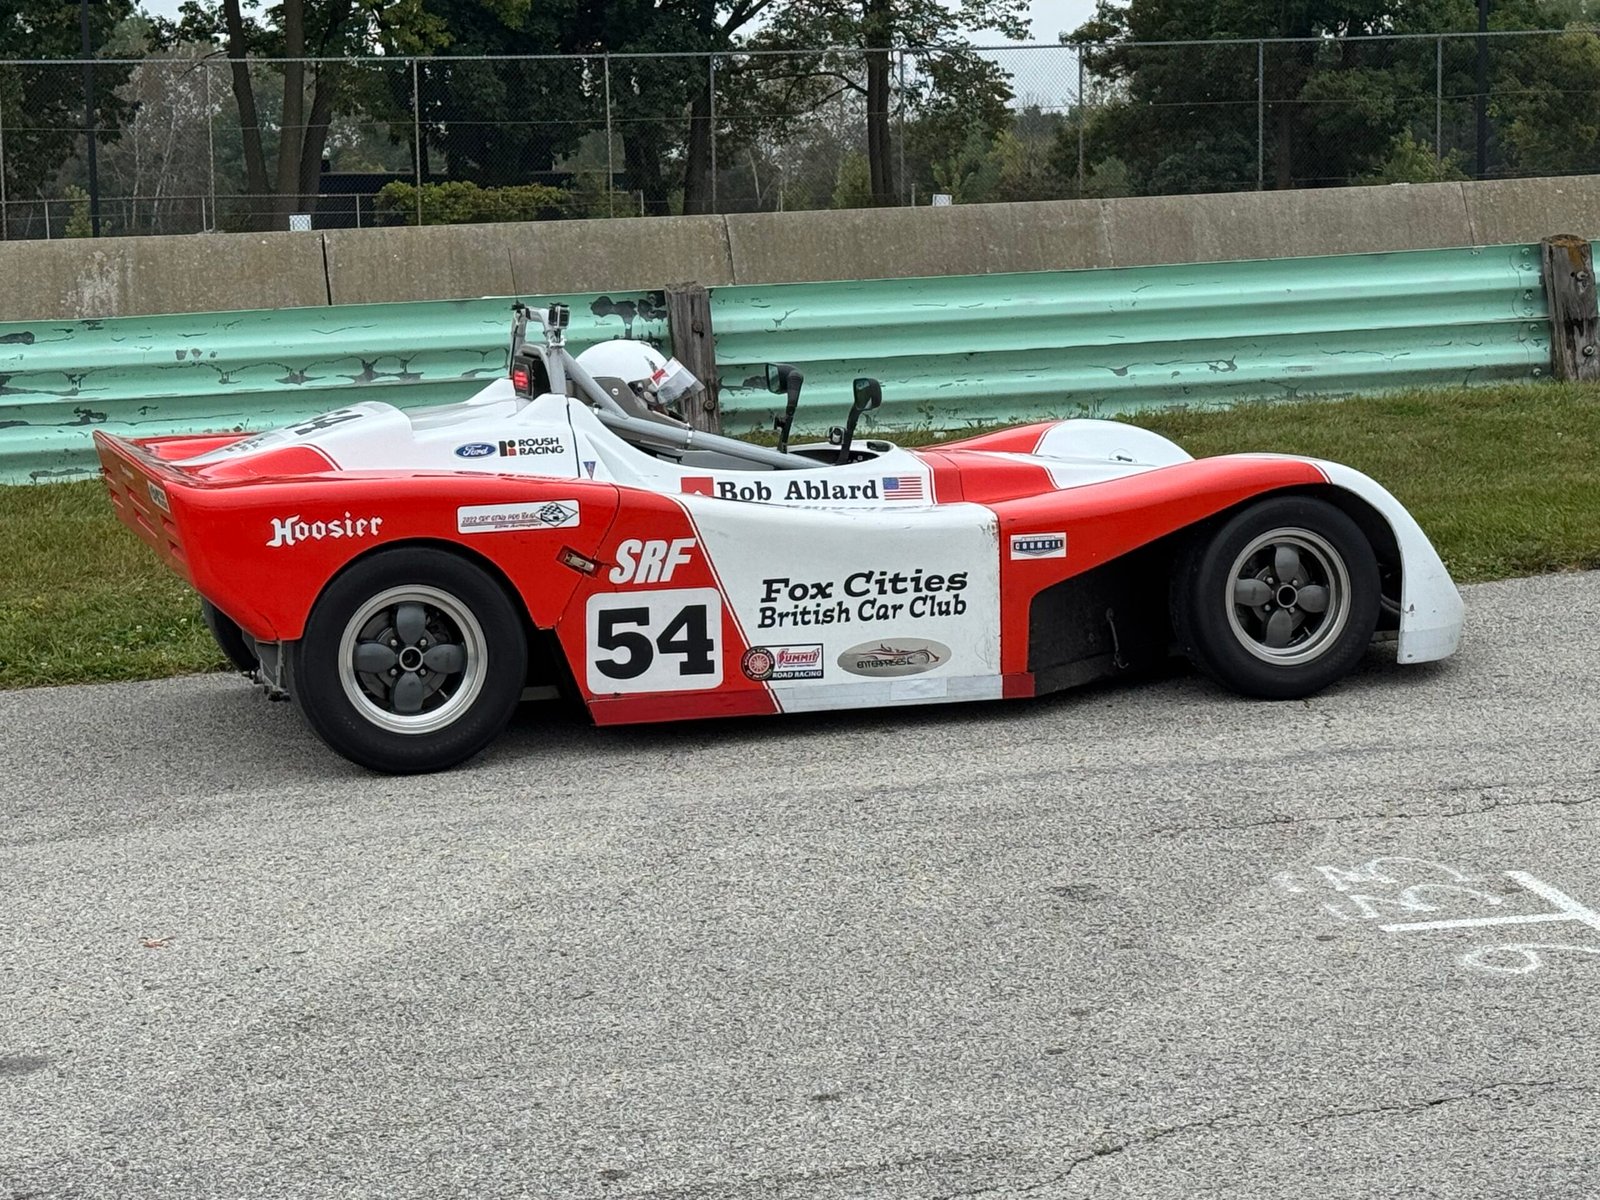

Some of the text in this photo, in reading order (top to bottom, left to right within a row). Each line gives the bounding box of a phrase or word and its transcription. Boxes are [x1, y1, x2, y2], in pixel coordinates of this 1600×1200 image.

[462, 444, 489, 456] Ford
[518, 437, 559, 447] ROUSH
[520, 446, 564, 456] RACING
[717, 480, 879, 500] Bob Ablard
[265, 511, 383, 548] Hoosier
[1015, 541, 1061, 549] COUNCIL
[608, 538, 697, 584] SRF
[760, 569, 968, 603] Fox Cities
[757, 593, 967, 629] British Car Club
[595, 604, 715, 680] 54
